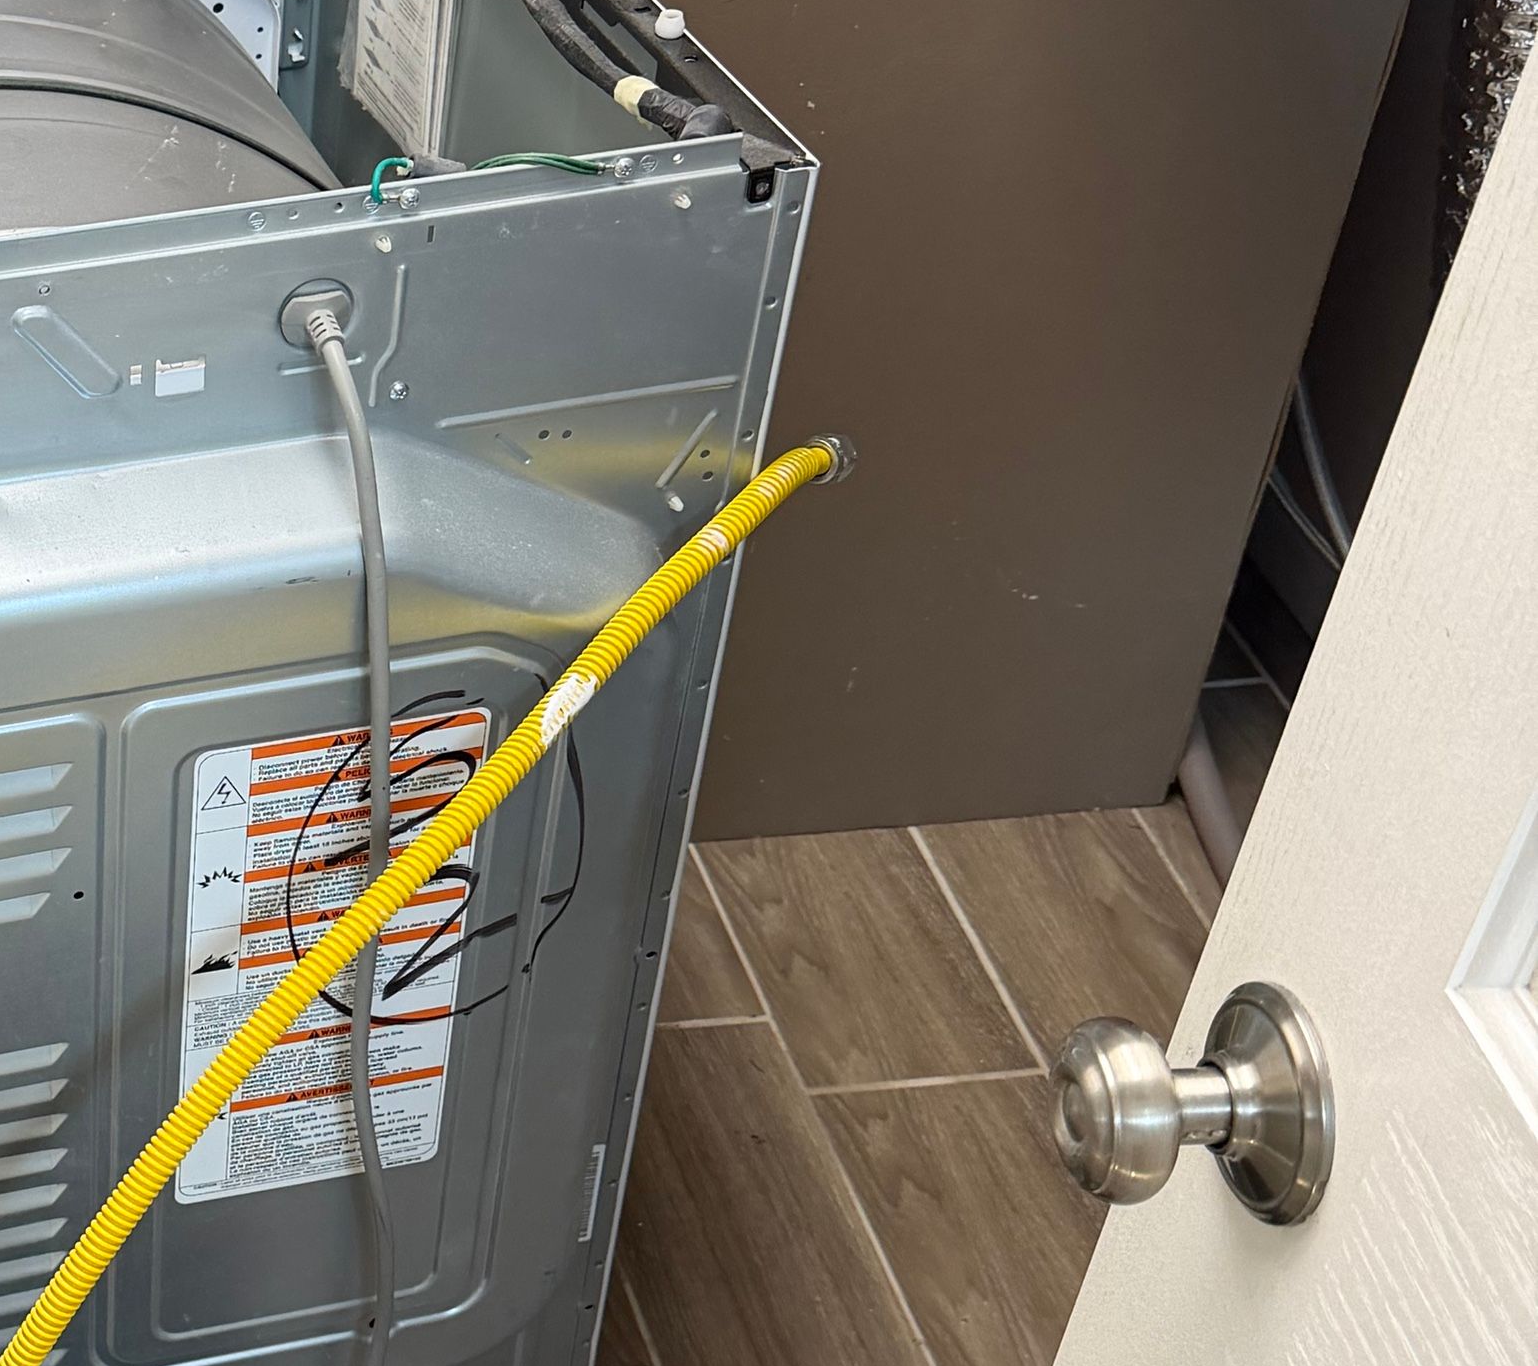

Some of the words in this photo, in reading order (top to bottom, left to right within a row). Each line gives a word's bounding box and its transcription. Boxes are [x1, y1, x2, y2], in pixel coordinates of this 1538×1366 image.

[259, 759, 299, 771] Disconnect
[301, 757, 323, 765] power
[259, 767, 287, 776] Replace
[299, 762, 318, 771] parts
[259, 773, 282, 782] Failure
[254, 840, 272, 848] Keep
[269, 934, 288, 942] heavy
[247, 948, 270, 956] Failure
[195, 1022, 226, 1032] CAUTION
[194, 1033, 227, 1042] WARNING
